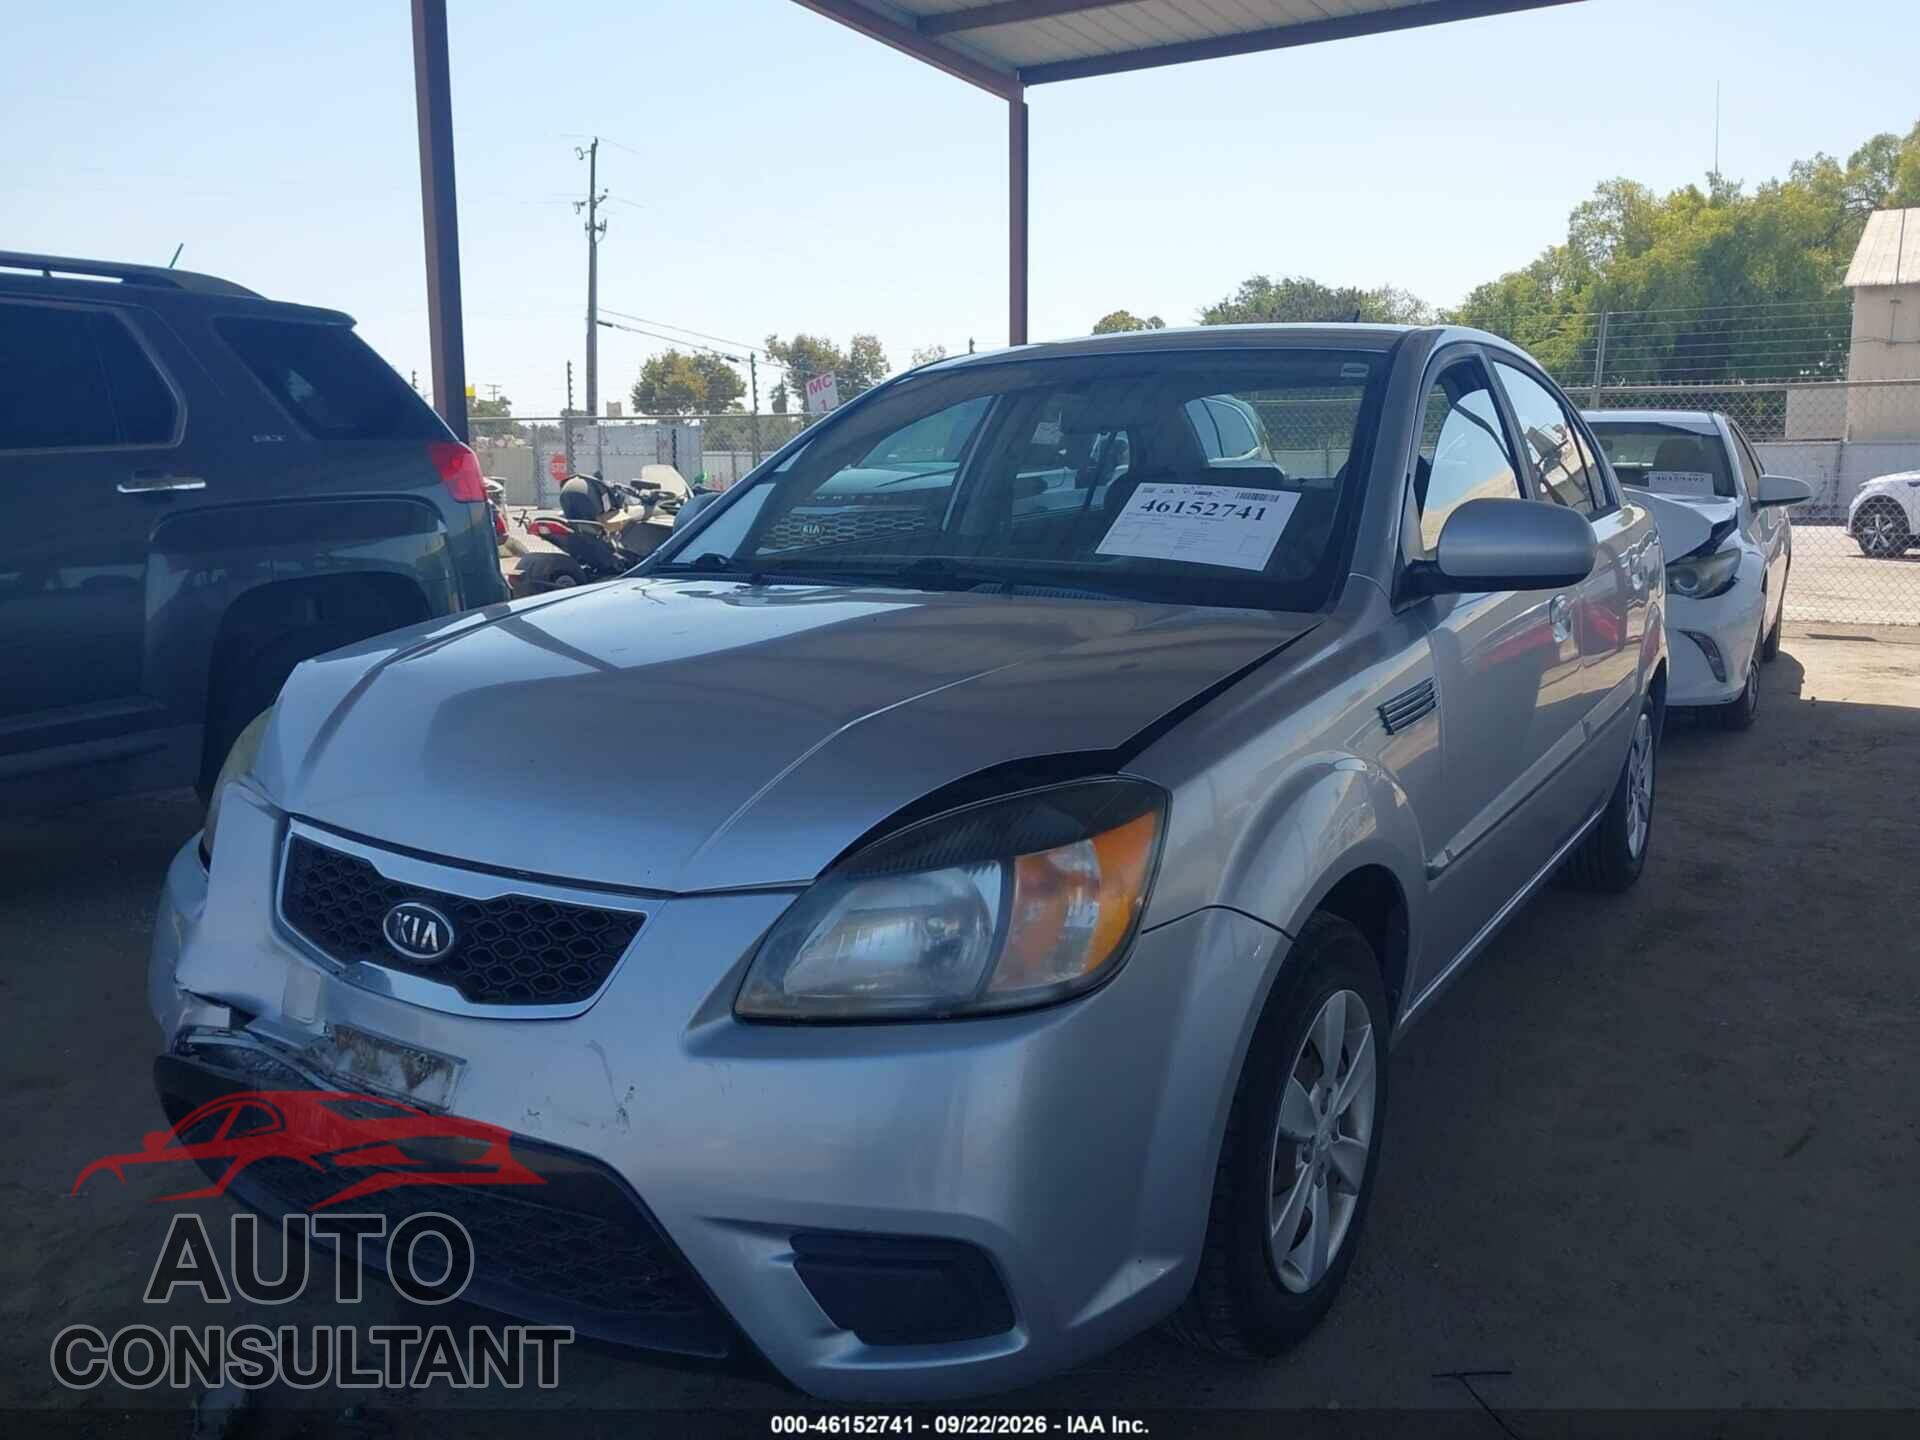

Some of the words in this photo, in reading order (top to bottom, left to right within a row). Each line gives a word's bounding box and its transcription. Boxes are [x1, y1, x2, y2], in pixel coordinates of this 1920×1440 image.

[809, 374, 832, 395] MC
[1140, 499, 1267, 521] 46152741
[392, 911, 439, 952] KIA
